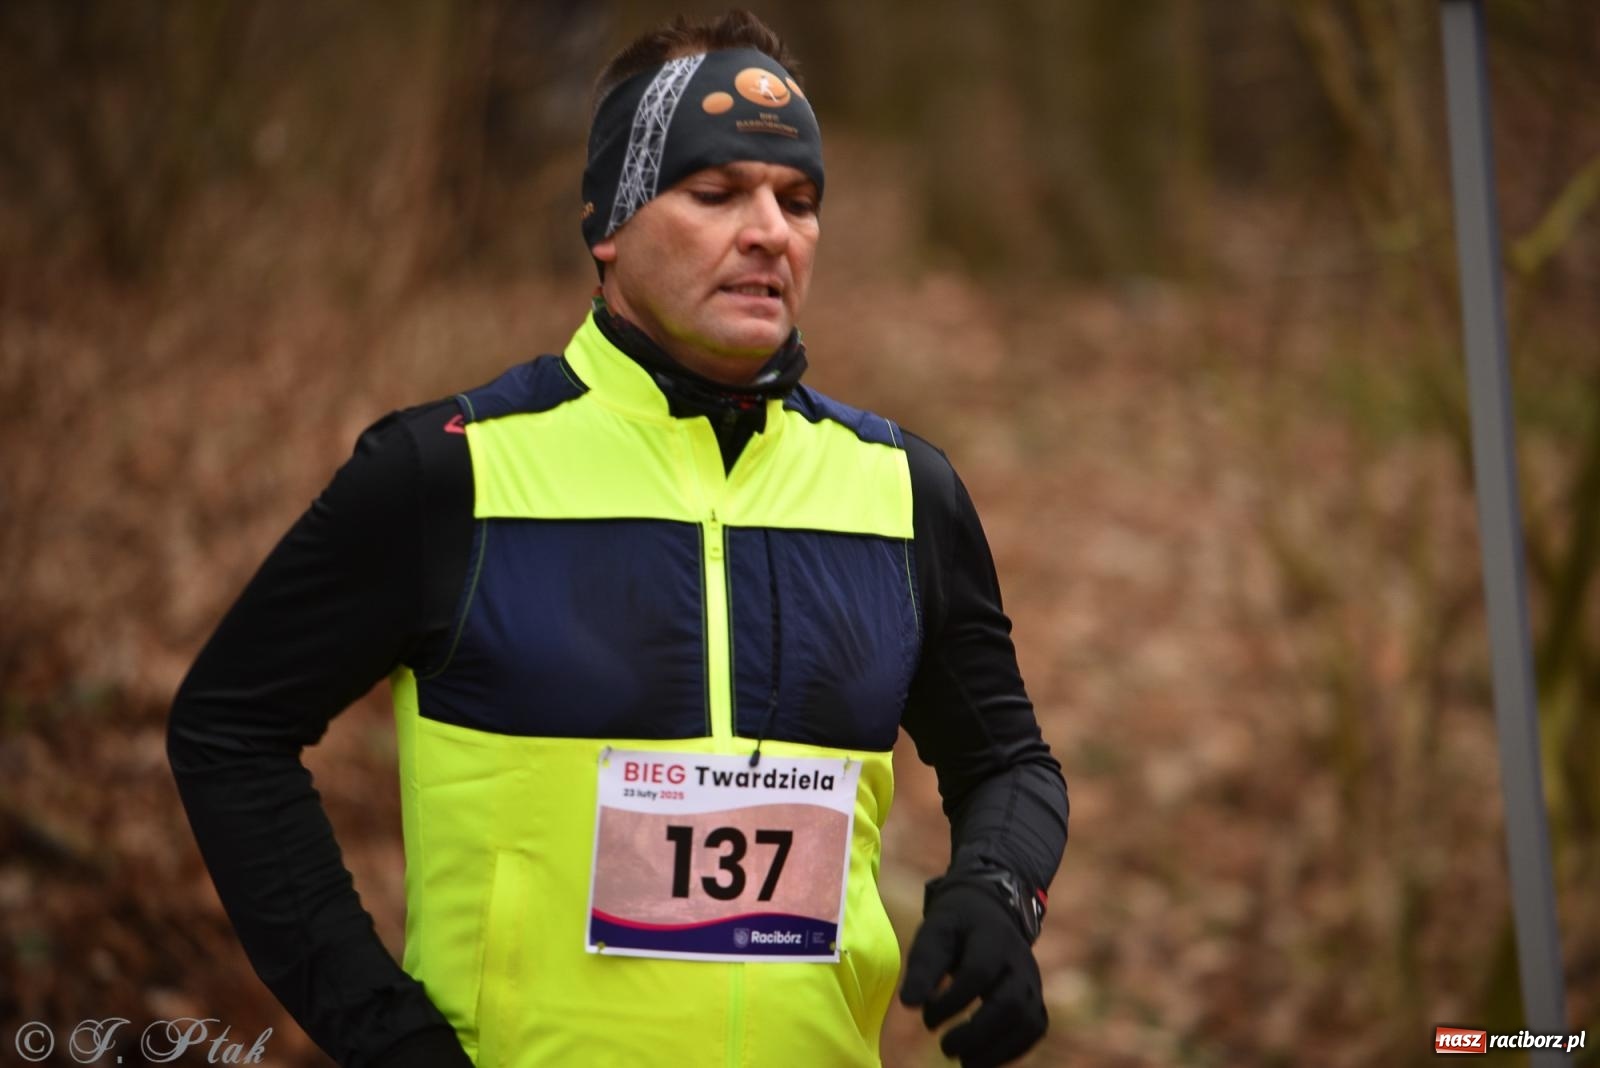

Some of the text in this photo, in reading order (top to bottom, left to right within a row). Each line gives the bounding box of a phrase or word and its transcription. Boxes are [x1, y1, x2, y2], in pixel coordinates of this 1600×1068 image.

[624, 761, 835, 791] BIEG Twardziela
[623, 788, 685, 801] 23 luty 2025
[665, 825, 794, 902] 137
[751, 930, 802, 944] Racibórz
